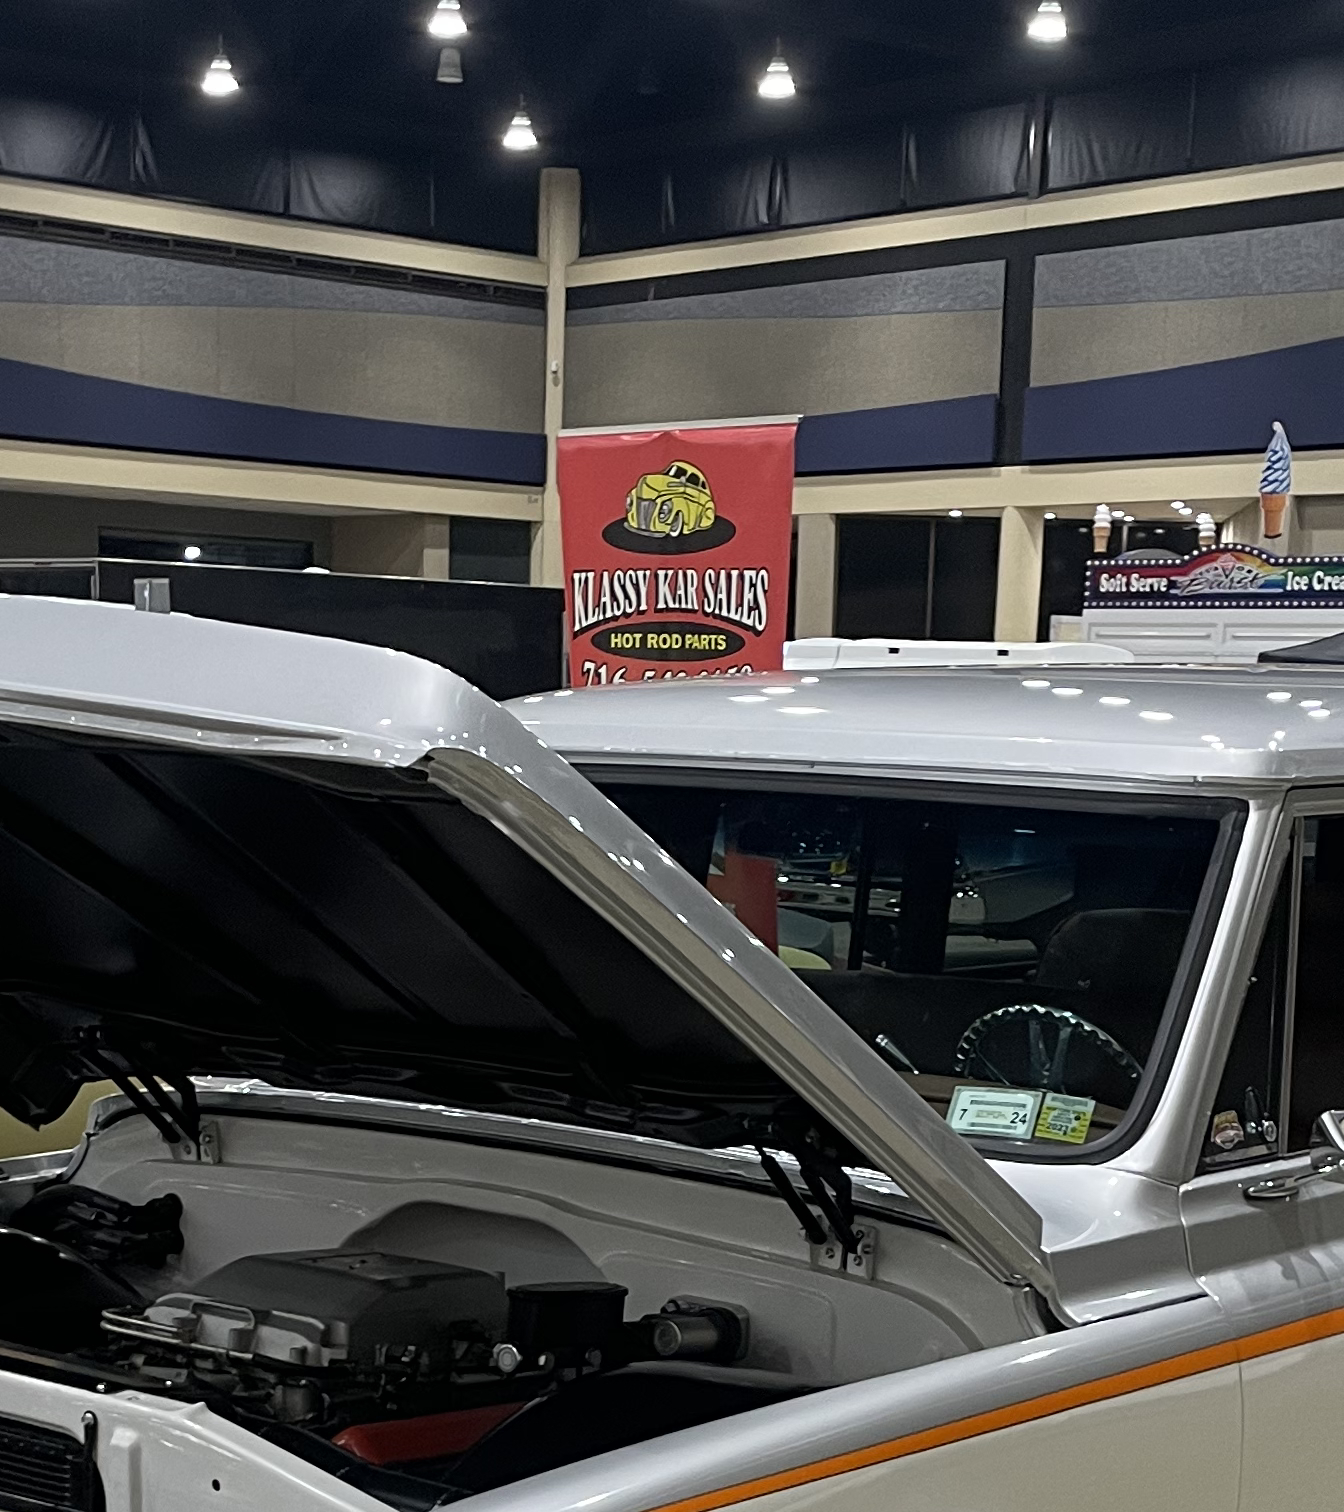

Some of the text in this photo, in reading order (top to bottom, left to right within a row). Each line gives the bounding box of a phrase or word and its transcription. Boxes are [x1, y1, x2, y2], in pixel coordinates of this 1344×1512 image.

[1099, 573, 1168, 592] Soft Serve
[1286, 571, 1309, 591] Ice
[572, 569, 769, 632] KLASSY KAR SALES
[610, 632, 727, 650] HOT ROD PARTS
[1009, 1111, 1028, 1125] 24
